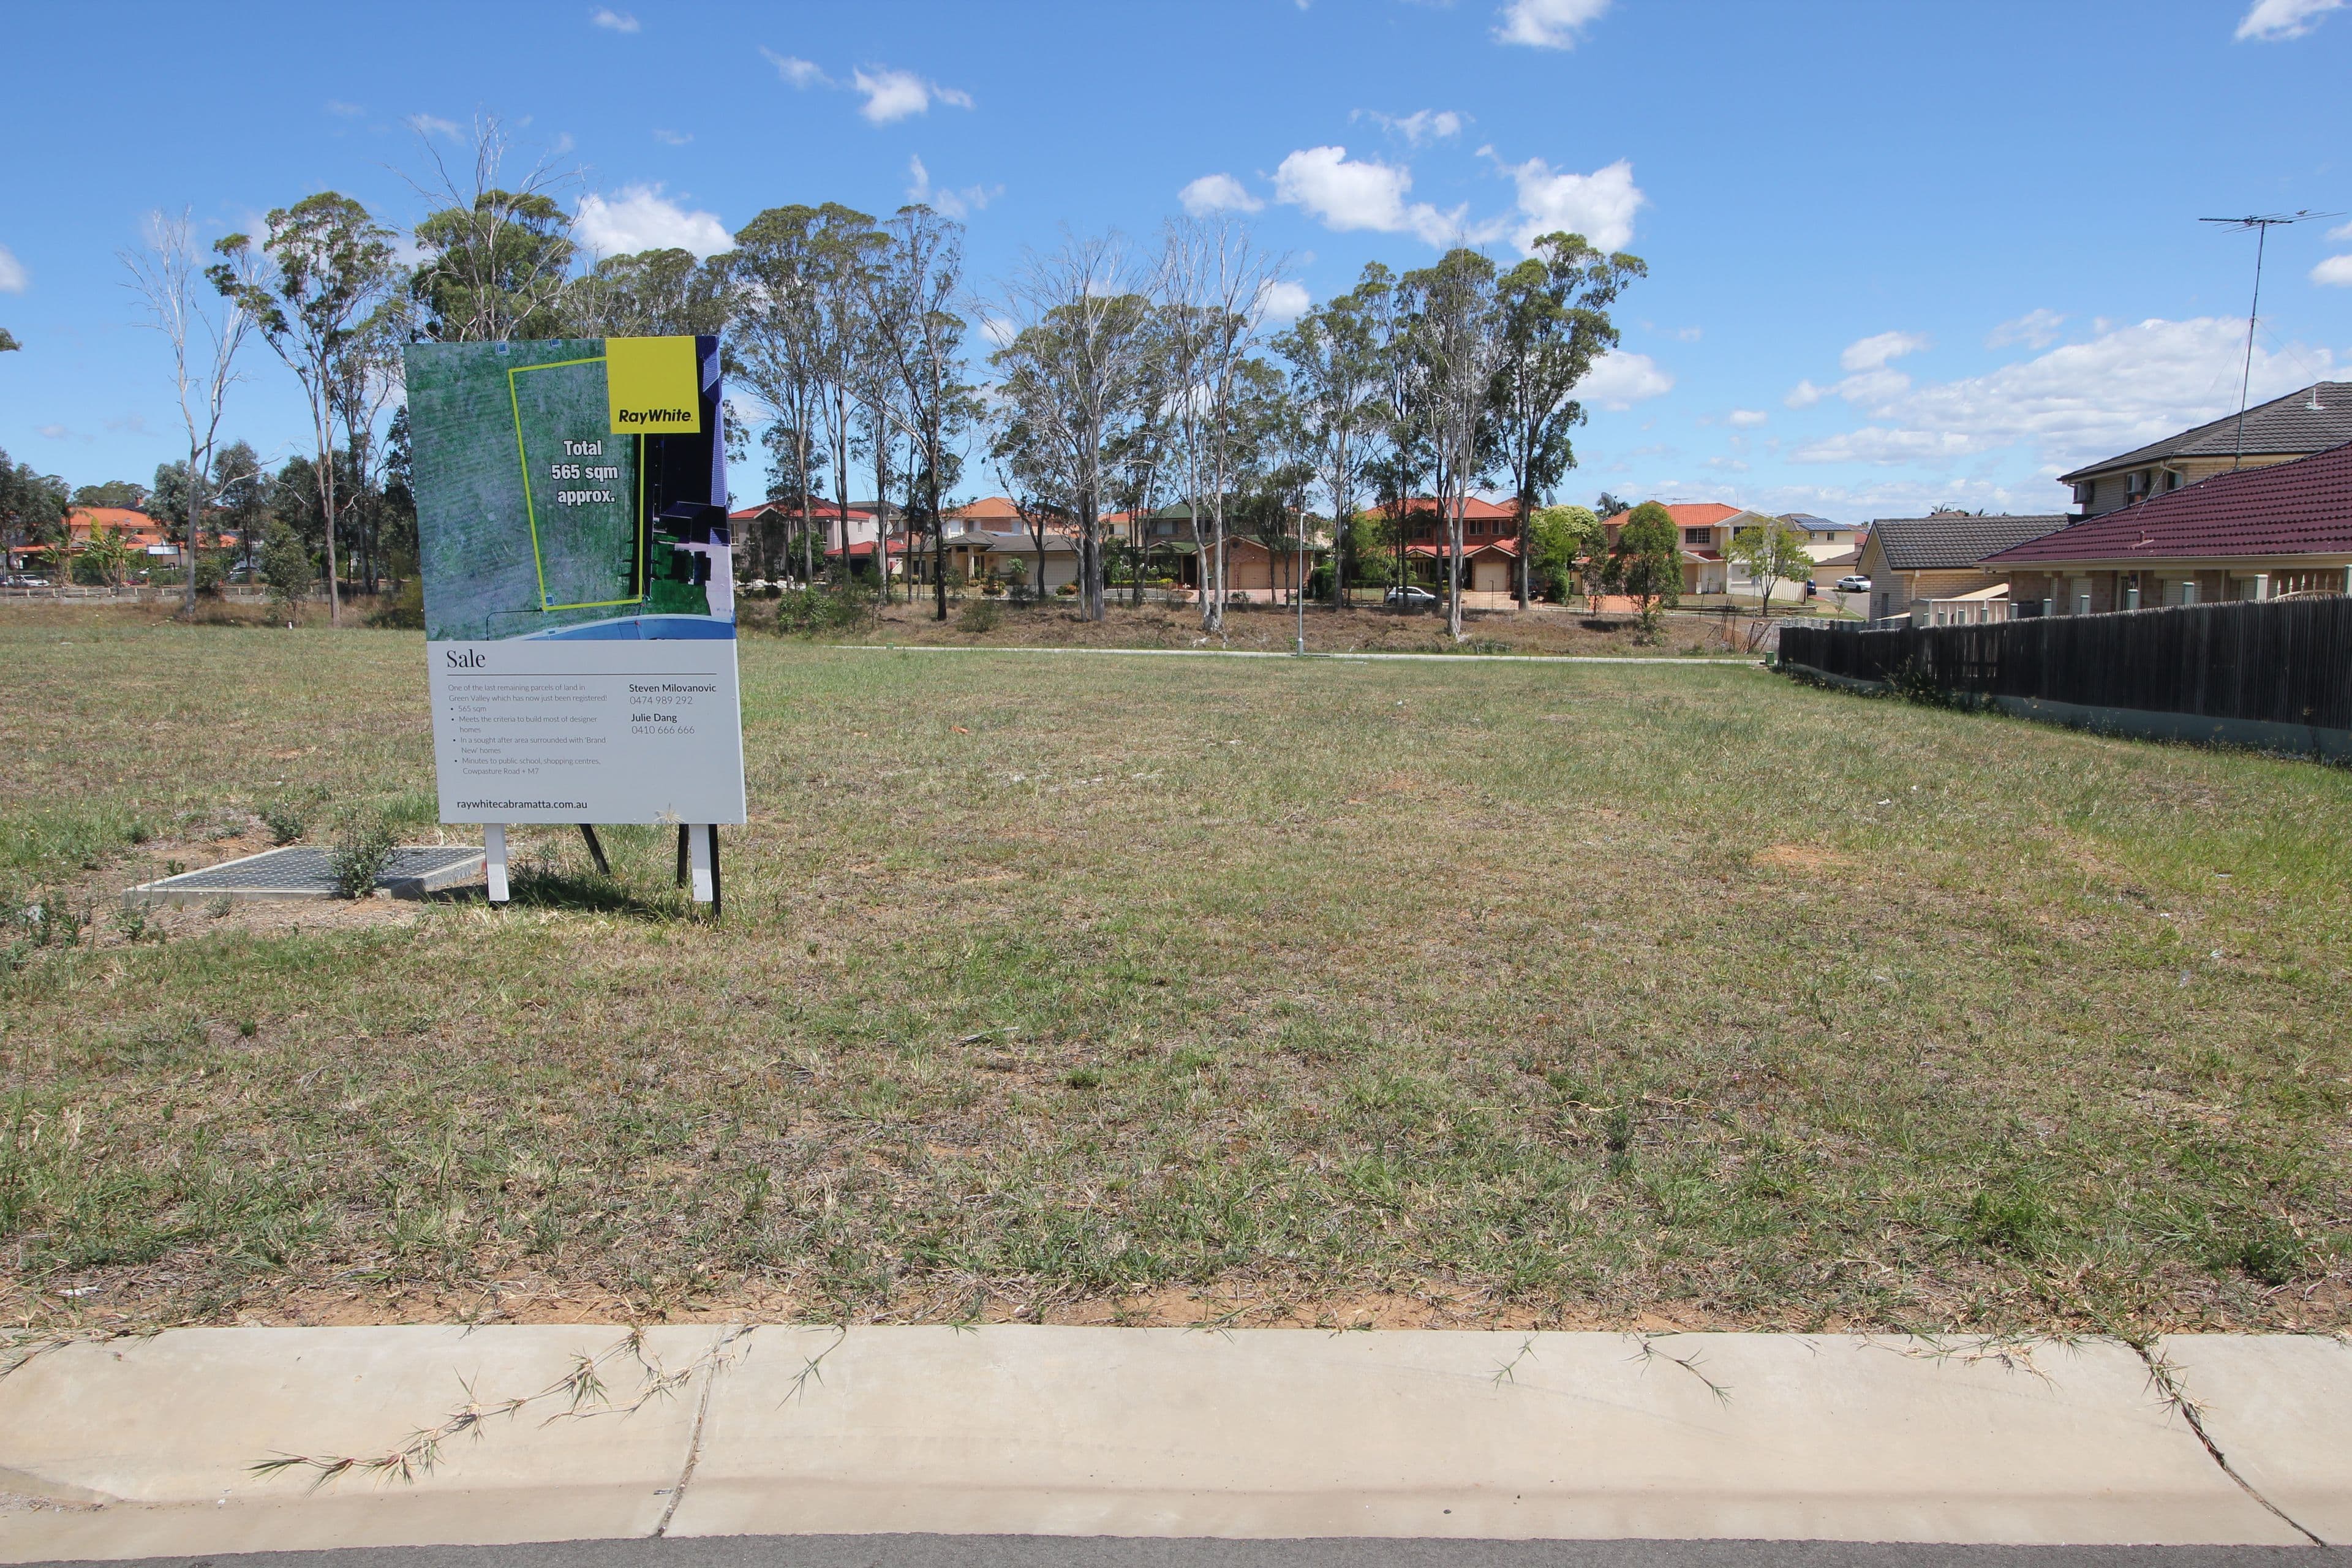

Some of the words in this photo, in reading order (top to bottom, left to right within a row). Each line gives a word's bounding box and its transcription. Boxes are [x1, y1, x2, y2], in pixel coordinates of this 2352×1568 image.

[563, 440, 603, 456] Total
[551, 464, 580, 480] 565
[585, 467, 619, 483] sqm
[557, 490, 616, 507] approx.
[447, 649, 486, 668] Sale
[654, 714, 677, 723] Dang
[457, 799, 587, 811] raywhitecabramatta.com.au
